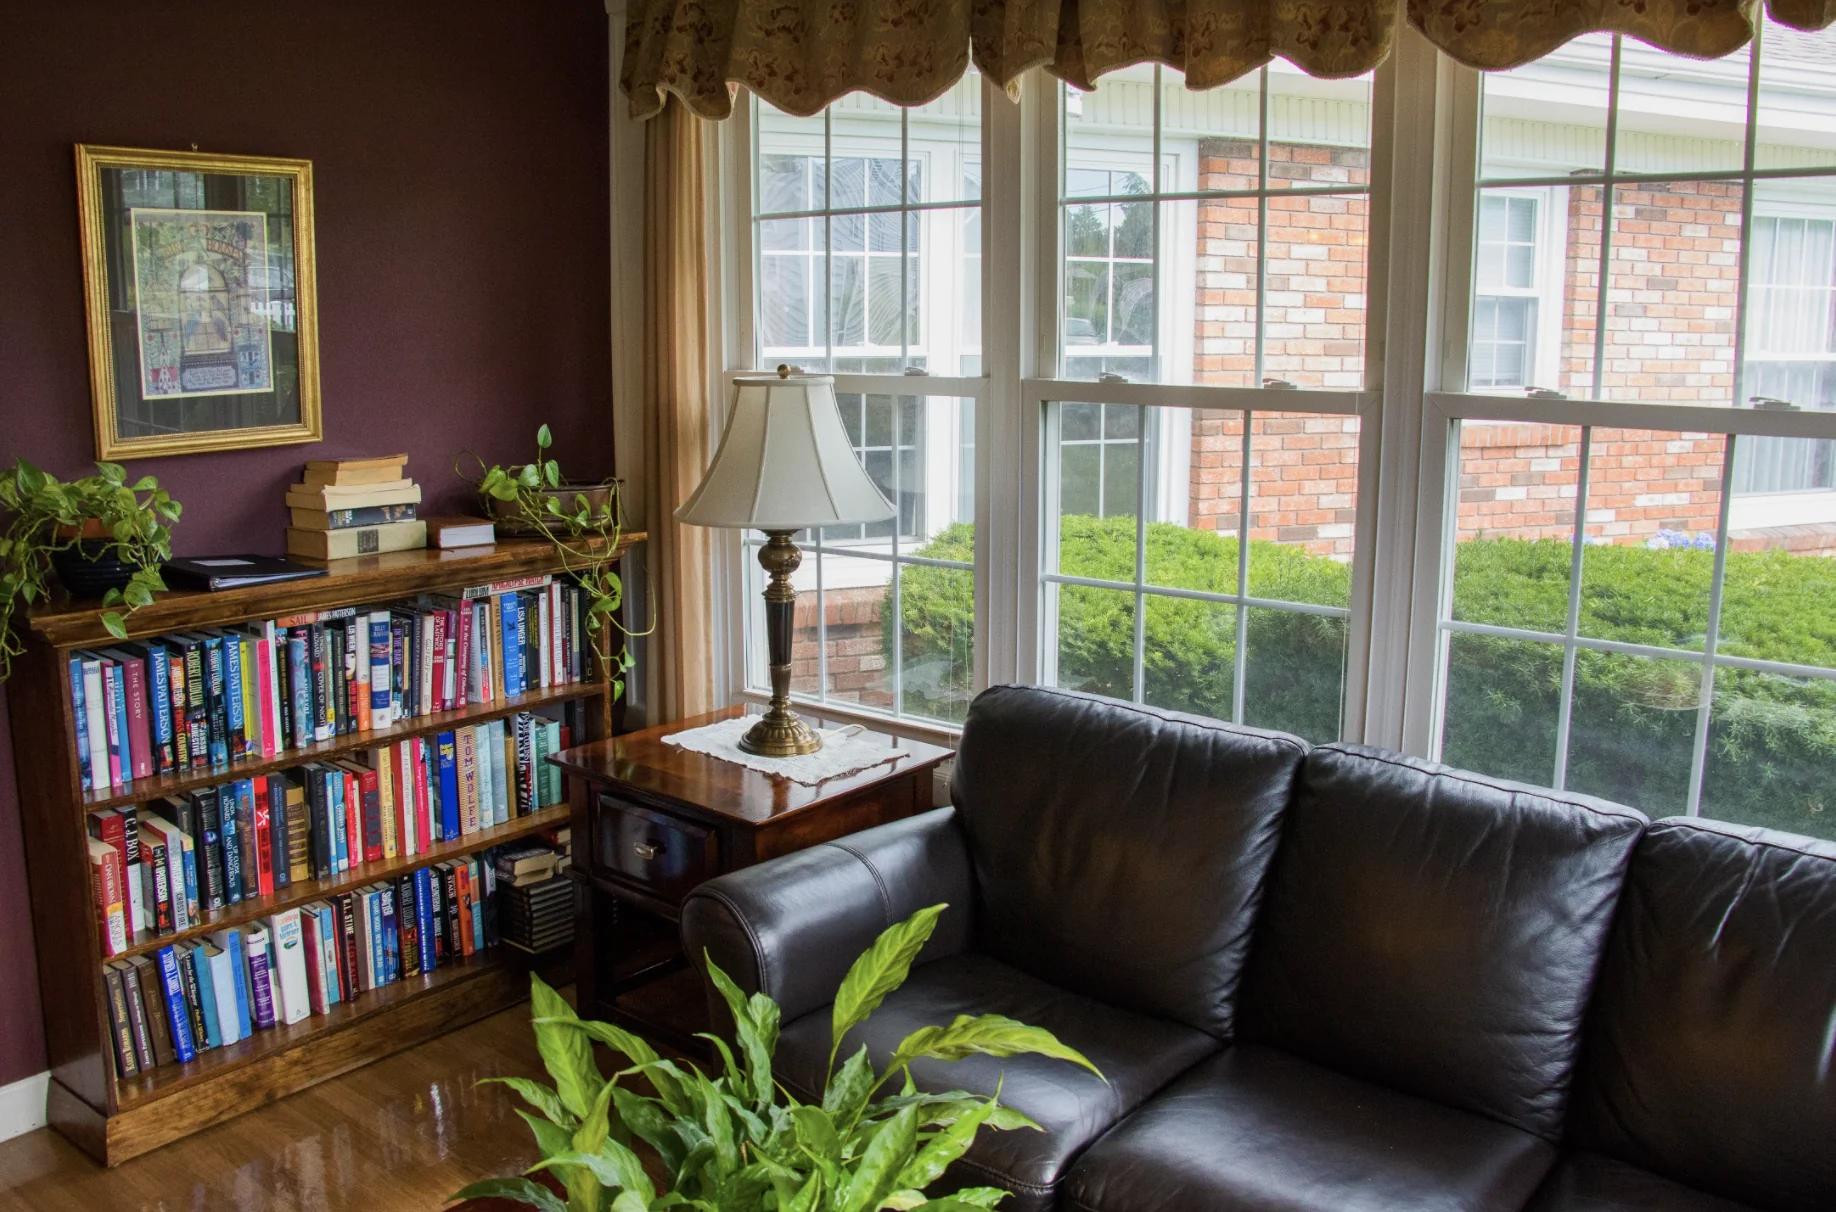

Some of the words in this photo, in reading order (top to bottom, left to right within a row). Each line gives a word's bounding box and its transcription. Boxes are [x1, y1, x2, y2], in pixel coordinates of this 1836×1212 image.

[466, 586, 489, 598] LUDLUM
[290, 615, 306, 625] SAIL
[317, 611, 331, 621] JAMES
[332, 607, 355, 617] PATTERSON
[435, 616, 440, 624] OF
[394, 628, 400, 636] IN
[153, 653, 165, 684] JAMES
[186, 650, 201, 678] ROBERT
[227, 641, 240, 672] JAMES
[173, 680, 184, 707] PATTERSON
[189, 679, 203, 707] LUDLUM
[211, 673, 221, 696] LUDLUM
[133, 692, 141, 719] STORY
[231, 673, 243, 730] PATTERSON
[319, 695, 325, 705] OF
[157, 685, 170, 743] PATTERSON
[175, 709, 184, 732] CROSS
[177, 733, 187, 762] COUNTRY
[191, 723, 200, 756] DIRECTIVE
[464, 735, 474, 767] TOM
[223, 796, 231, 821] HOWARD
[465, 771, 476, 827] WOLFE
[125, 817, 136, 828] C.
[126, 839, 139, 861] BOX
[105, 864, 113, 879] DAN
[227, 851, 236, 888] DANGEROUS
[106, 880, 115, 903] BROWN
[157, 871, 168, 903] PATTERSON
[401, 882, 413, 906] ROBERT
[175, 892, 185, 914] CROSS
[178, 915, 186, 927] FIRE
[344, 915, 354, 935] STINE
[403, 906, 415, 929] LUDLUM
[114, 915, 123, 946] ANGELS
